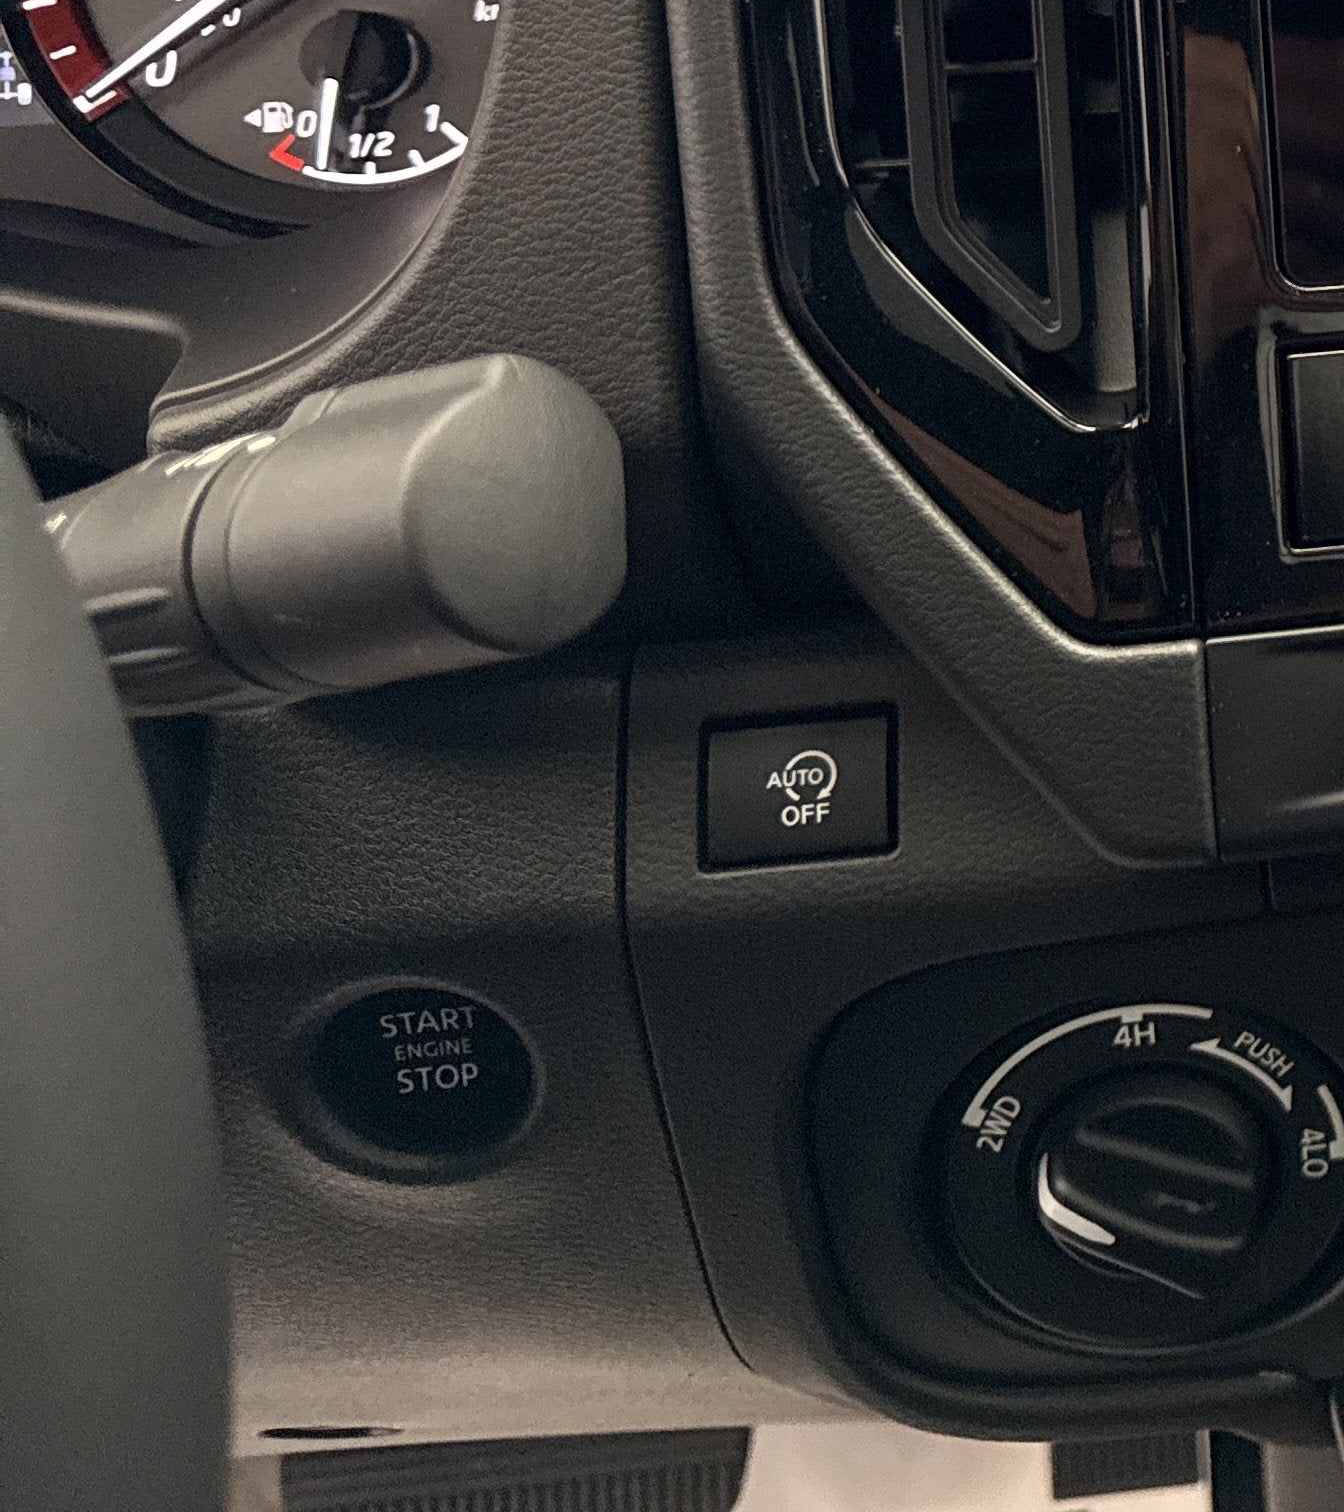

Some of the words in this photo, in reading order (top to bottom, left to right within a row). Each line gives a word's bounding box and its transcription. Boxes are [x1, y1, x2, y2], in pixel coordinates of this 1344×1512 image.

[296, 109, 318, 138] 0
[424, 103, 440, 133] 1
[347, 130, 396, 159] 1/2
[766, 767, 824, 790] AUTO
[781, 802, 831, 828] OFF
[379, 1005, 477, 1039] START
[1113, 1022, 1158, 1049] 4H
[394, 1039, 475, 1062] ENGINE
[1233, 1030, 1295, 1078] PUSH
[396, 1062, 480, 1095] STOP
[975, 1094, 1021, 1154] 2WD
[1300, 1127, 1329, 1178] 4LO
